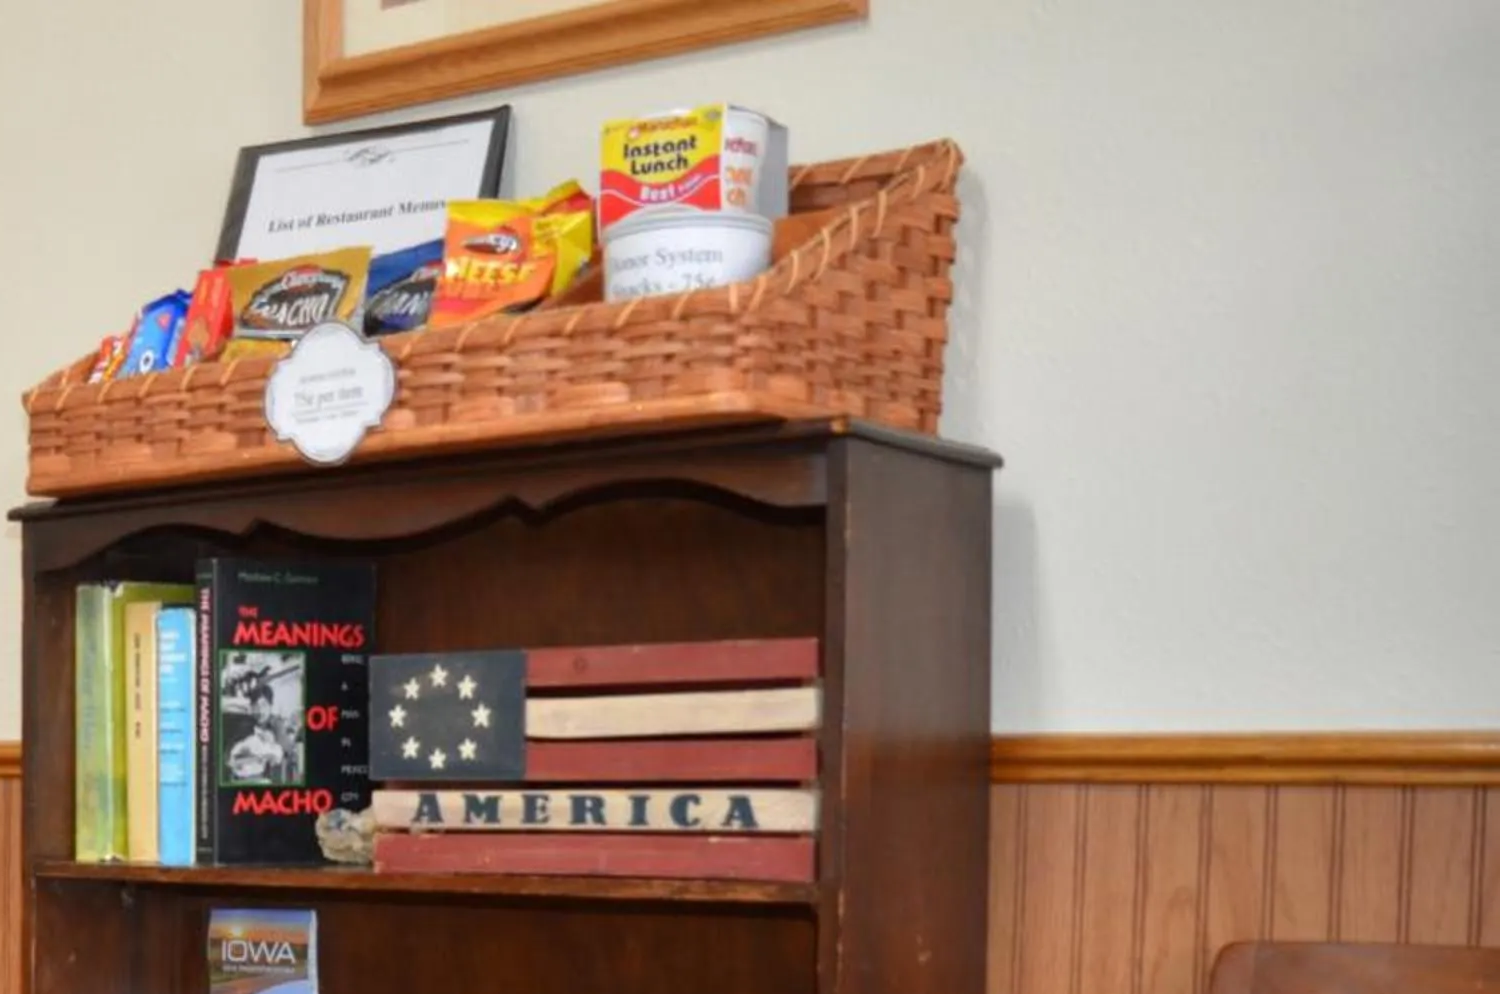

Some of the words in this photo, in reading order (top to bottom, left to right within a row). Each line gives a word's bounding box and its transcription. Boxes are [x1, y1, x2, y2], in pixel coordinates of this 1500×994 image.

[623, 136, 697, 158] Instant
[630, 155, 689, 175] Lunch
[268, 219, 295, 233] List
[297, 215, 315, 229] of
[316, 206, 395, 227] Restaurant
[655, 246, 724, 268] System
[238, 606, 258, 617] THE
[233, 620, 365, 647] MEANINGS
[307, 705, 339, 730] OF
[232, 788, 332, 815] MACHO
[410, 791, 760, 831] AMERICA
[221, 939, 298, 964] IOWA
